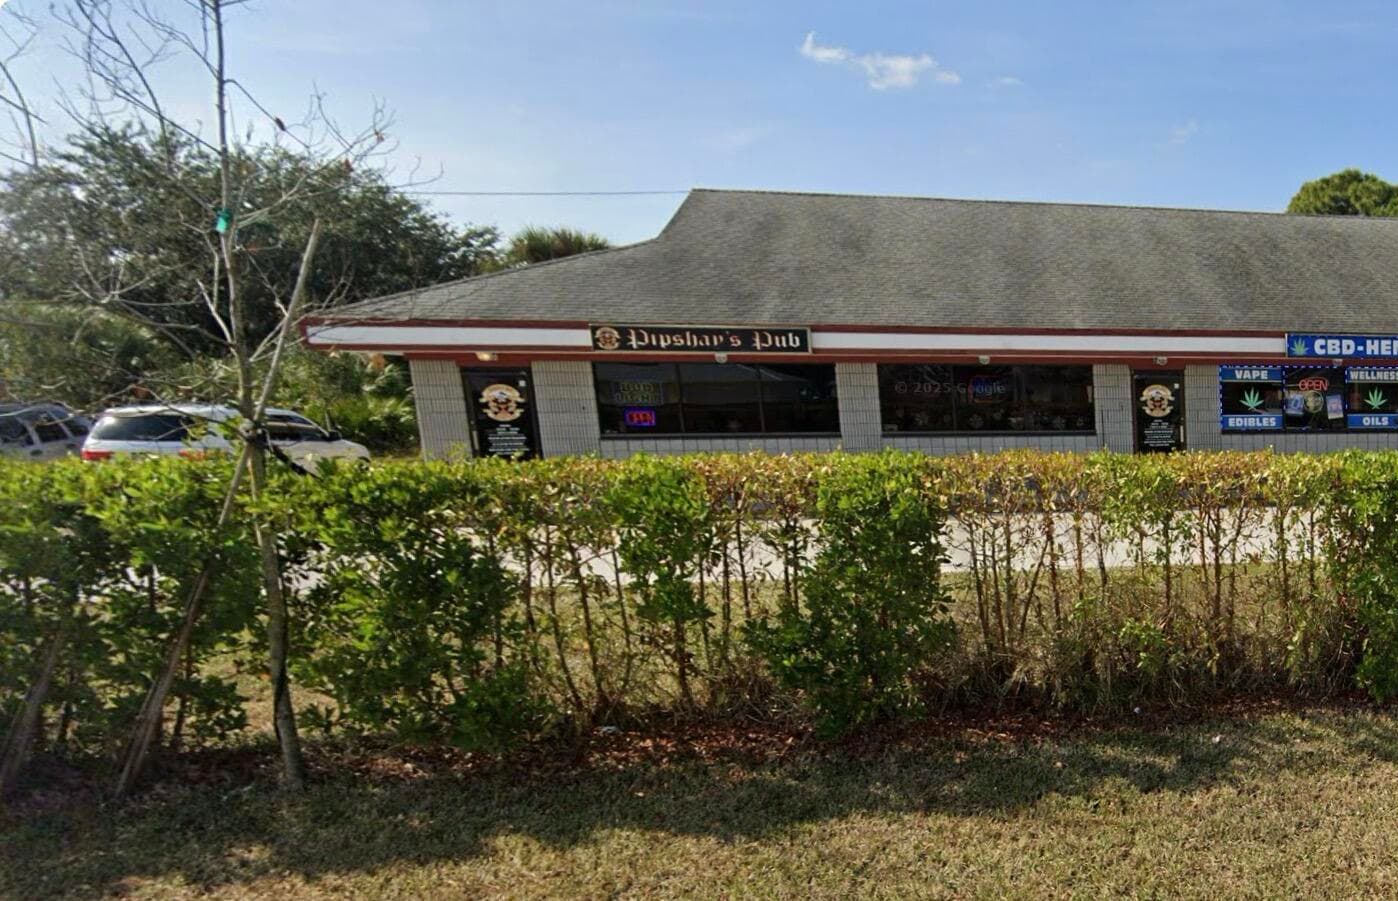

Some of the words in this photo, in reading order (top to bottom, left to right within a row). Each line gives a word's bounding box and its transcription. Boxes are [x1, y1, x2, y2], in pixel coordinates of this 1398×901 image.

[627, 329, 742, 349] Pipshay's
[752, 331, 801, 349] Pub
[1235, 370, 1268, 380] VAPE
[1299, 379, 1328, 391] OPEN
[1228, 417, 1276, 427] EDIBLES
[1363, 416, 1389, 426] OILS
